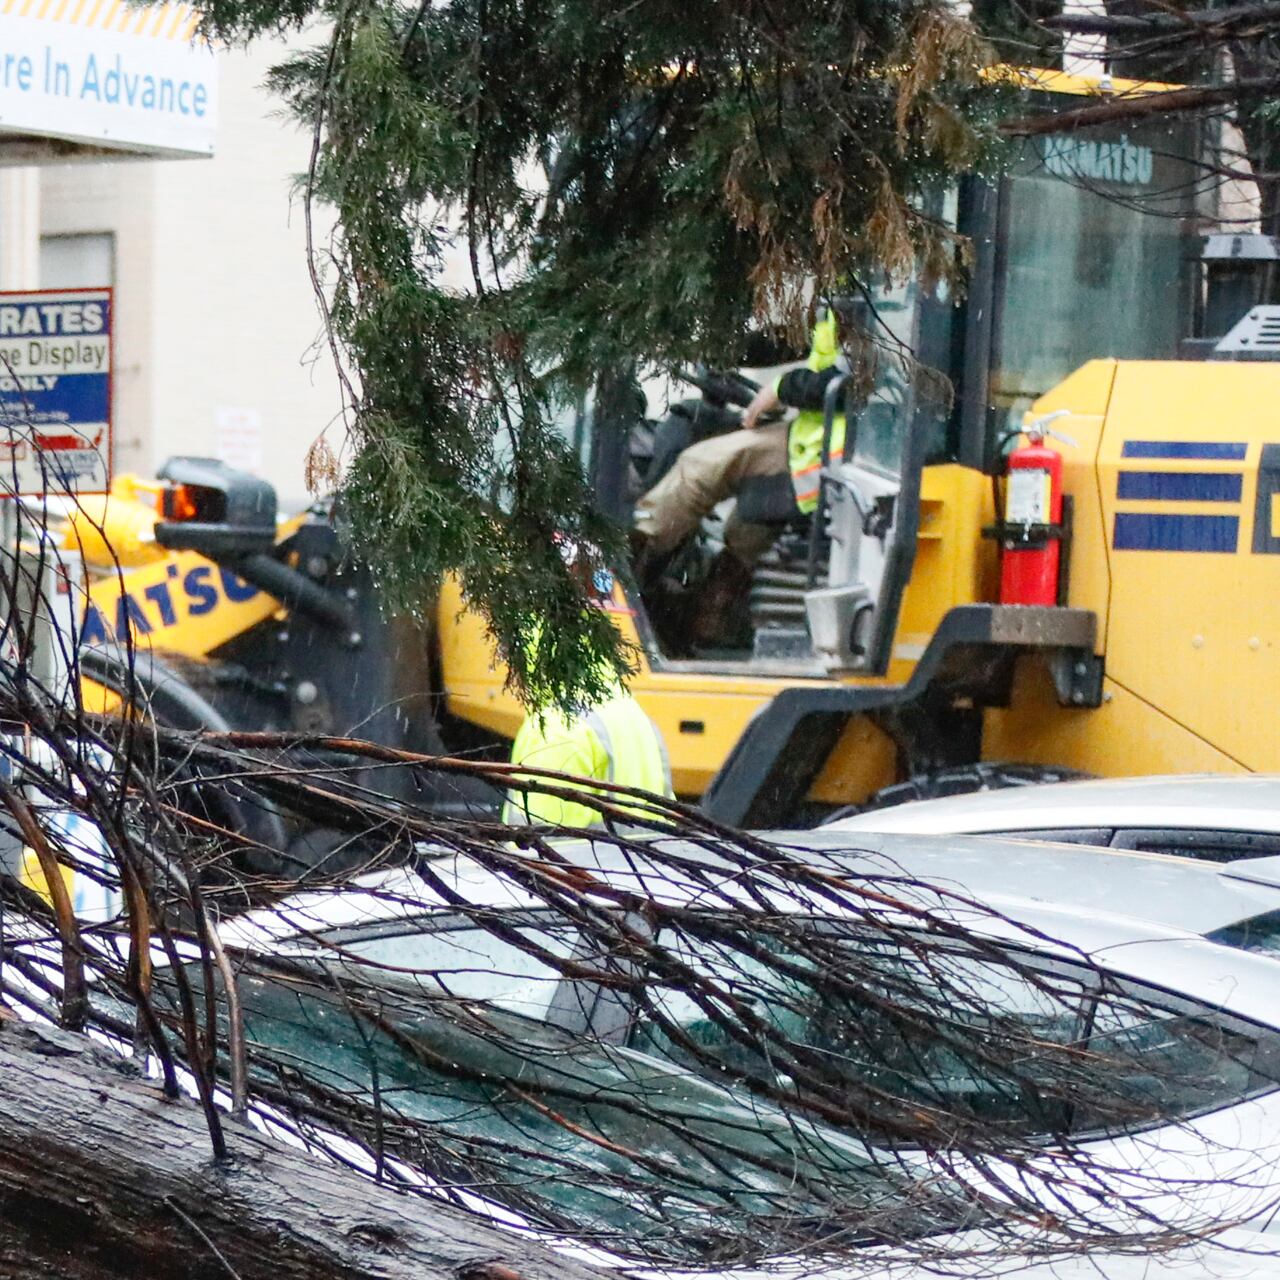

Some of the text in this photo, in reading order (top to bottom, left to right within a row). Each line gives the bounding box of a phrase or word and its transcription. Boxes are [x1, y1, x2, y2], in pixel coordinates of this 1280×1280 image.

[44, 45, 71, 97] In
[80, 53, 208, 117] Advance
[1044, 134, 1153, 184] KOMATSU
[29, 339, 107, 372] Display
